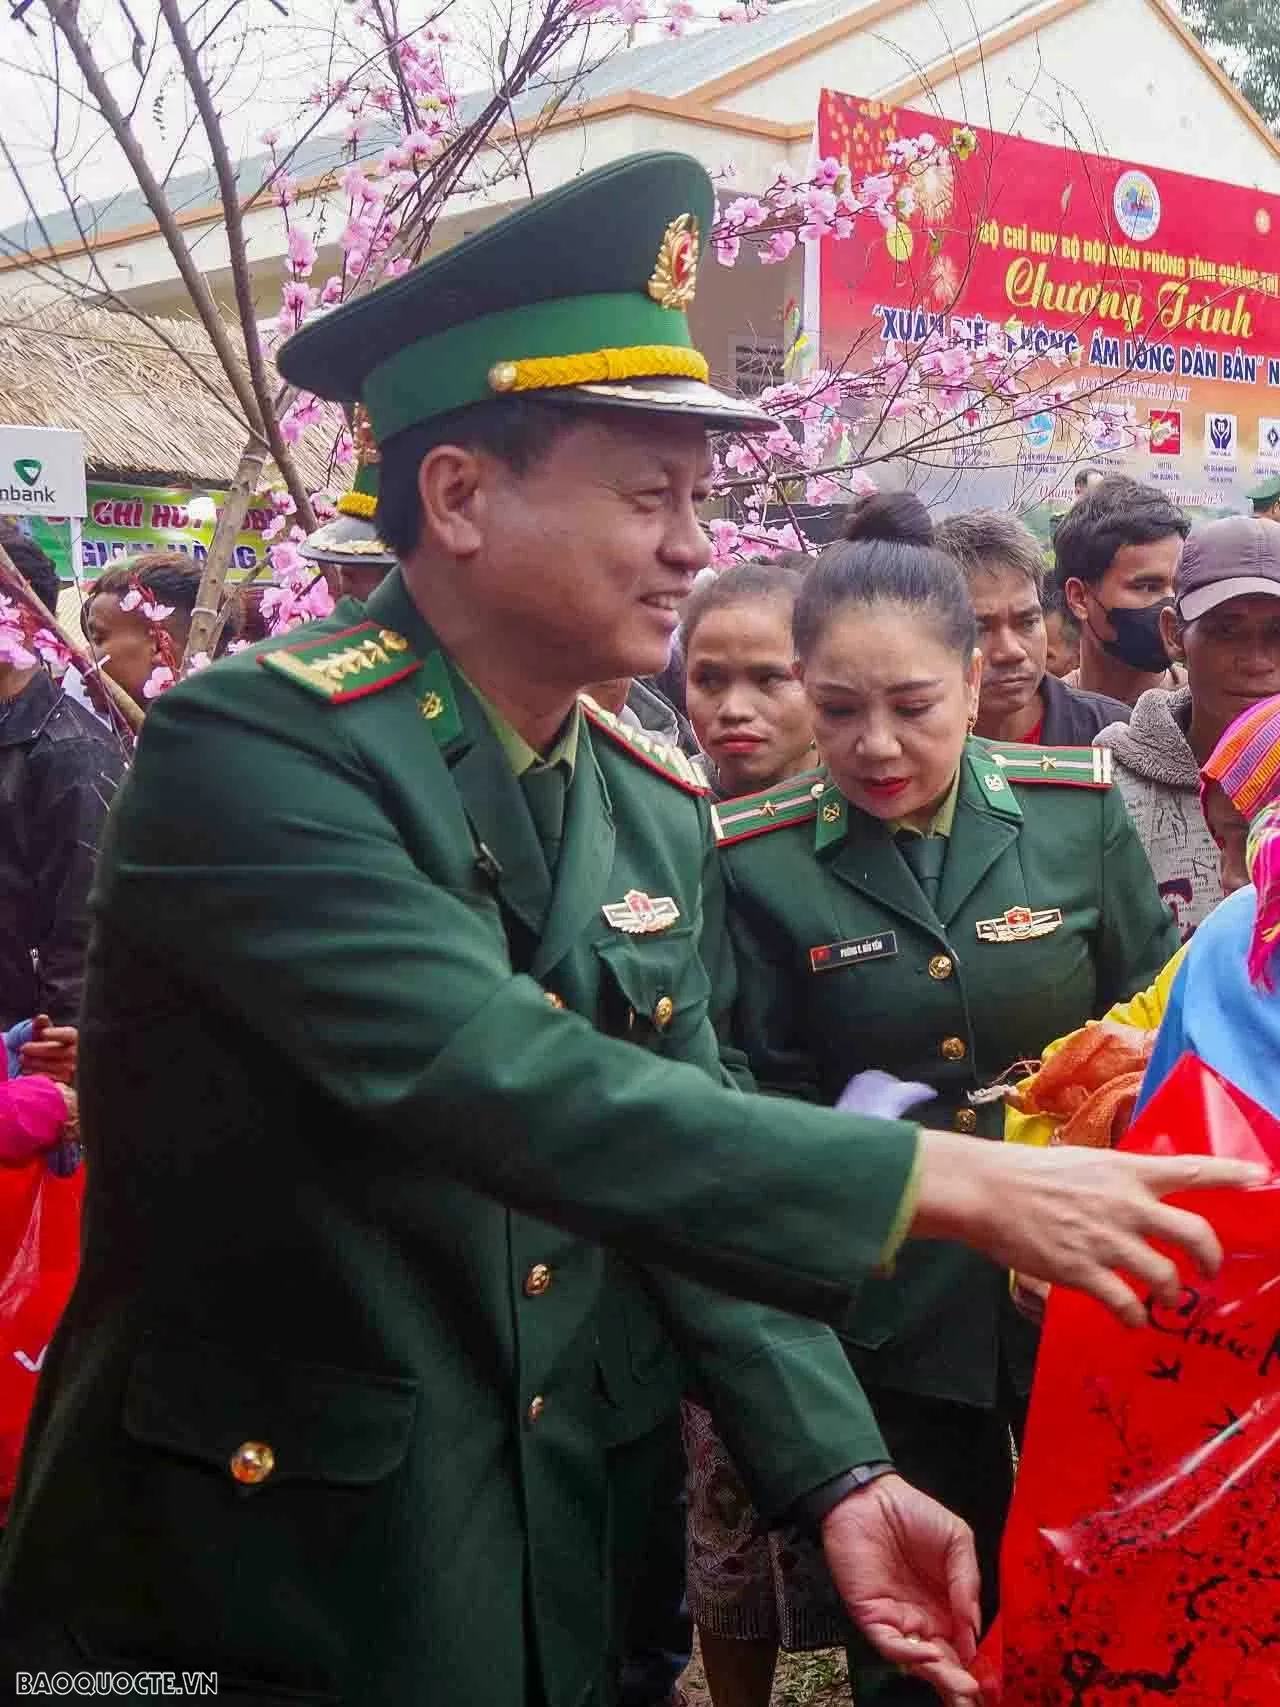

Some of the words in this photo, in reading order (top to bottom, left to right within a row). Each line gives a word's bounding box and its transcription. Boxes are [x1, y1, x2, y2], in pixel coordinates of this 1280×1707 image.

[1031, 231, 1058, 257] HUY
[1062, 233, 1080, 263] BỘ
[1005, 256, 1144, 332] Chương
[1158, 281, 1254, 338] Trình
[1181, 343, 1218, 378] DÂN
